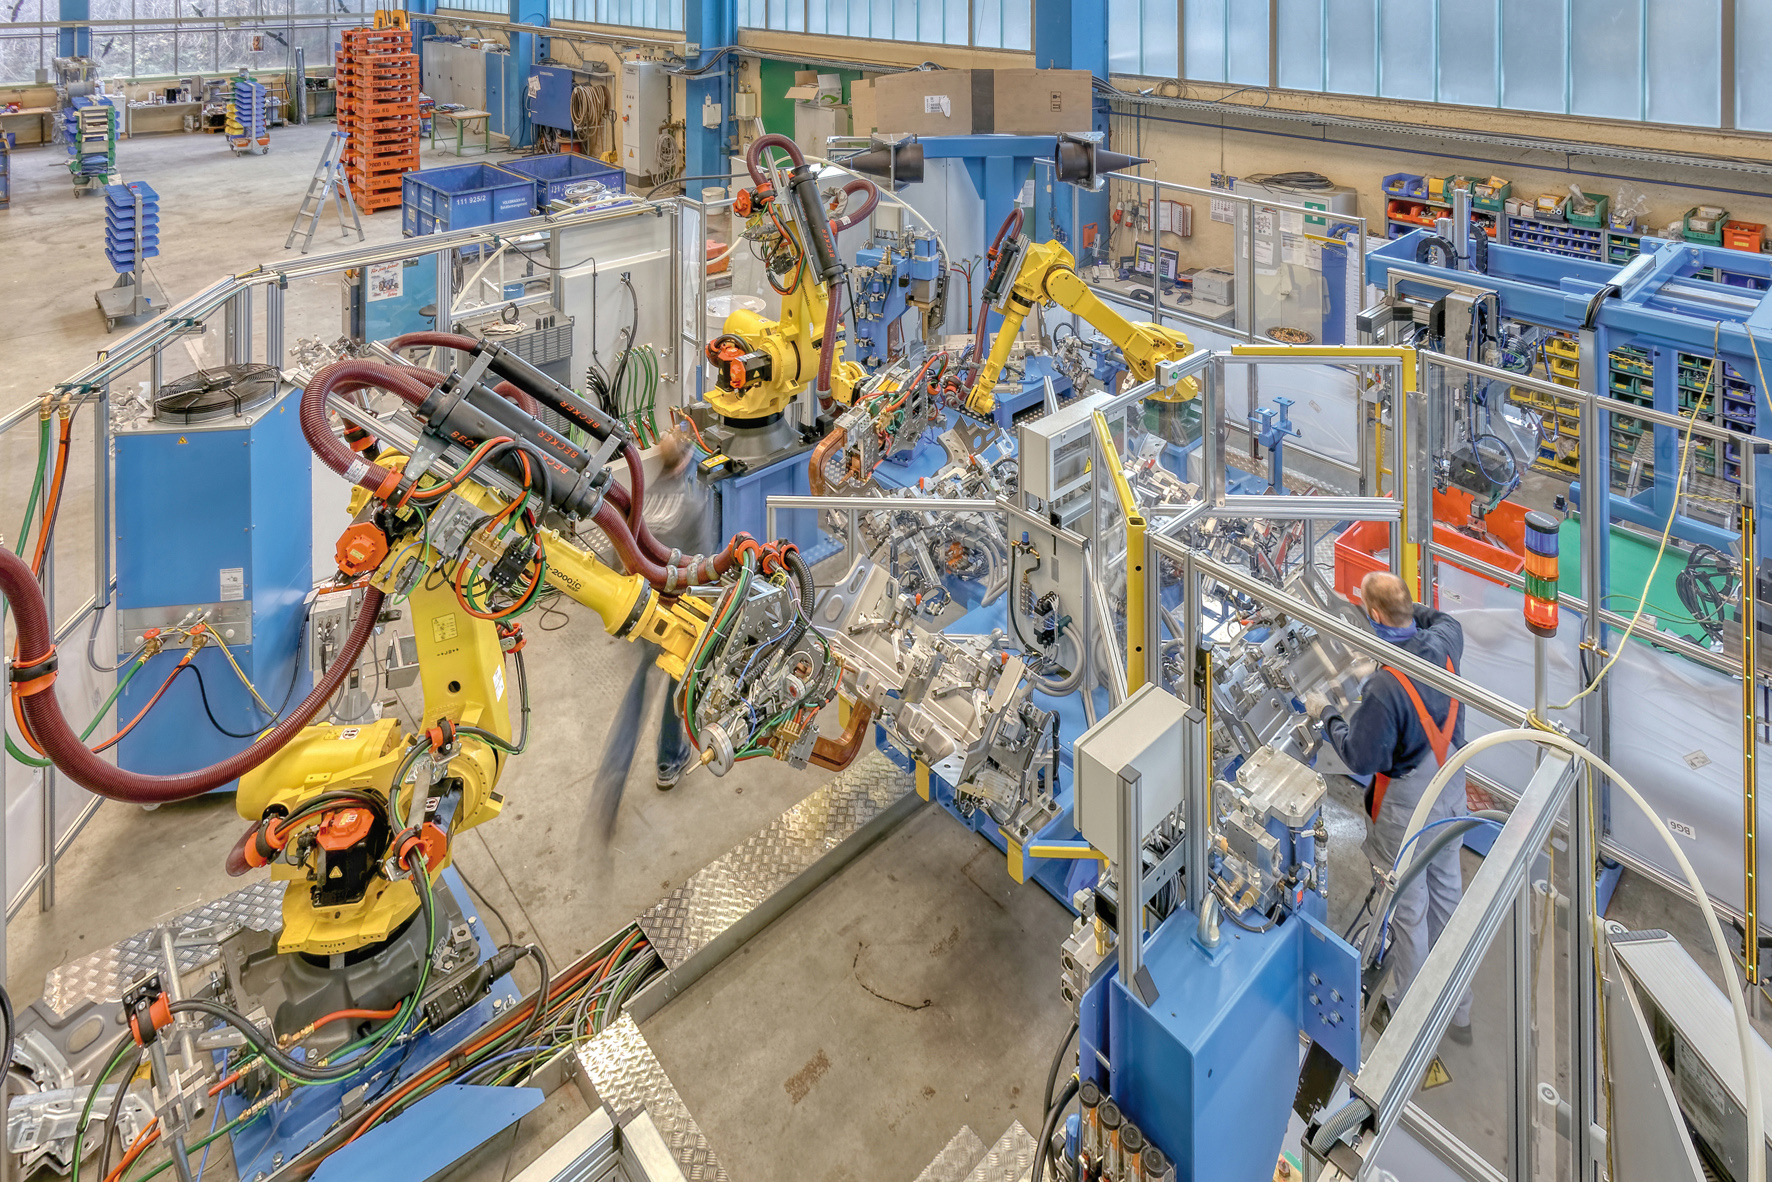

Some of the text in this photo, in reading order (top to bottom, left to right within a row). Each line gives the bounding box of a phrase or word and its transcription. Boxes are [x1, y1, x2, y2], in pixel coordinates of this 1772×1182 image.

[469, 195, 486, 204] 925/2
[822, 228, 836, 258] BECKER
[990, 252, 1003, 280] BECKER
[560, 400, 600, 429] BECKER
[538, 430, 580, 459] BECKER
[1670, 821, 1690, 835] BG6
